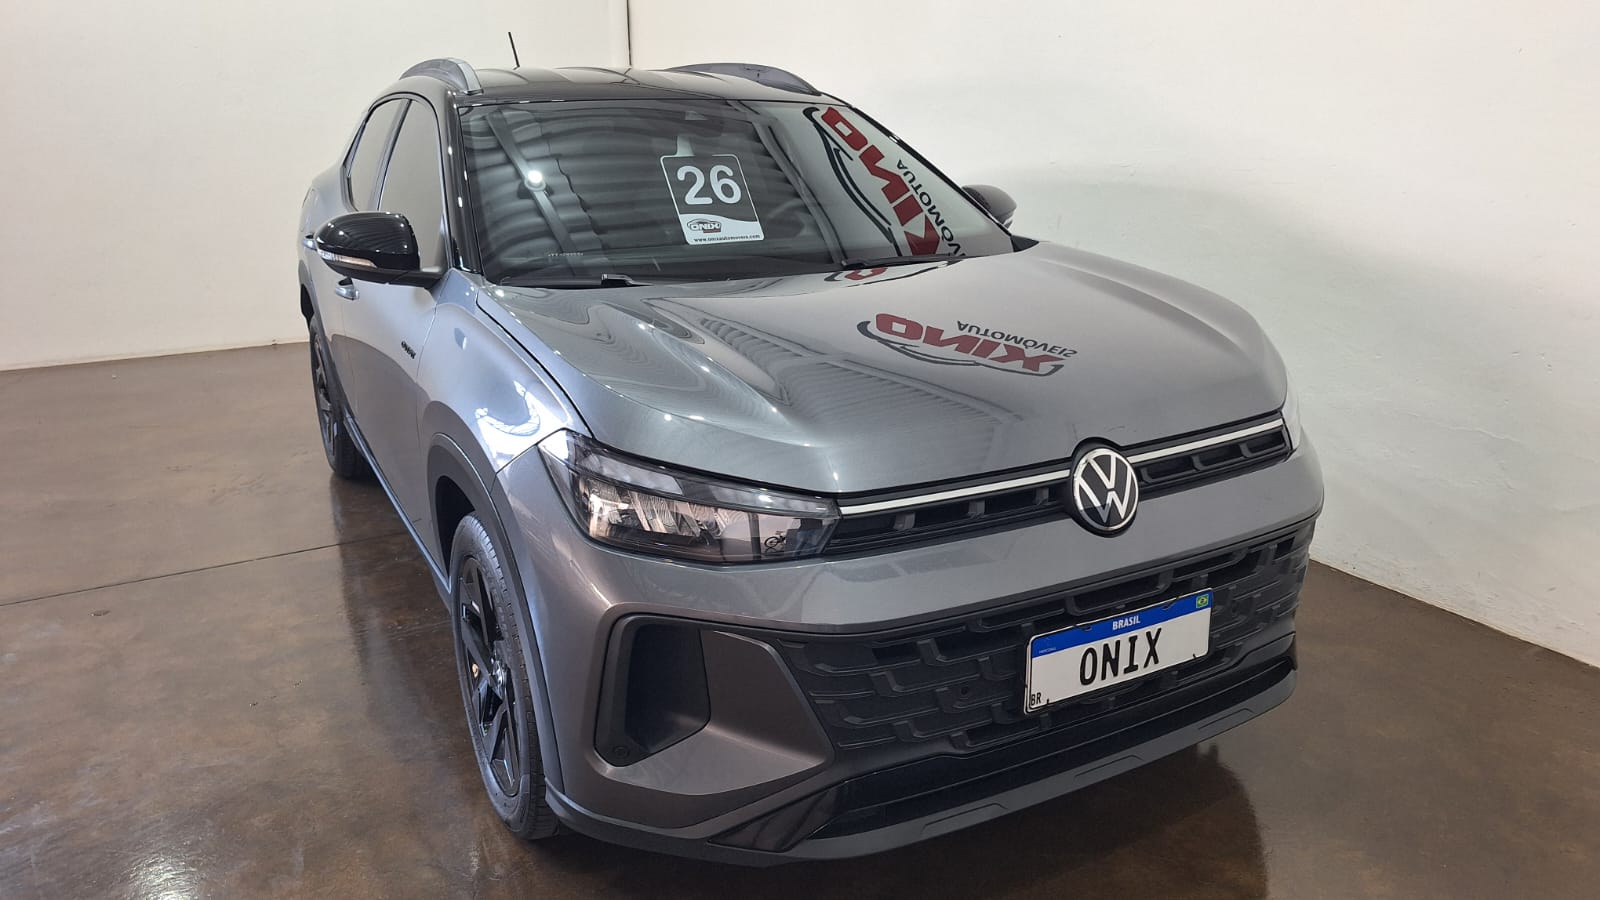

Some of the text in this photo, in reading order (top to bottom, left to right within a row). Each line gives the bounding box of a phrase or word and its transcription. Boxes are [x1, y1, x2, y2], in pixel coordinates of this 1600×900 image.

[677, 164, 742, 205] 26
[690, 223, 721, 231] ONIX
[1076, 450, 1136, 526] VW
[1112, 615, 1141, 631] BRASIL
[1079, 627, 1162, 686] ONIX
[1030, 692, 1042, 706] BR
